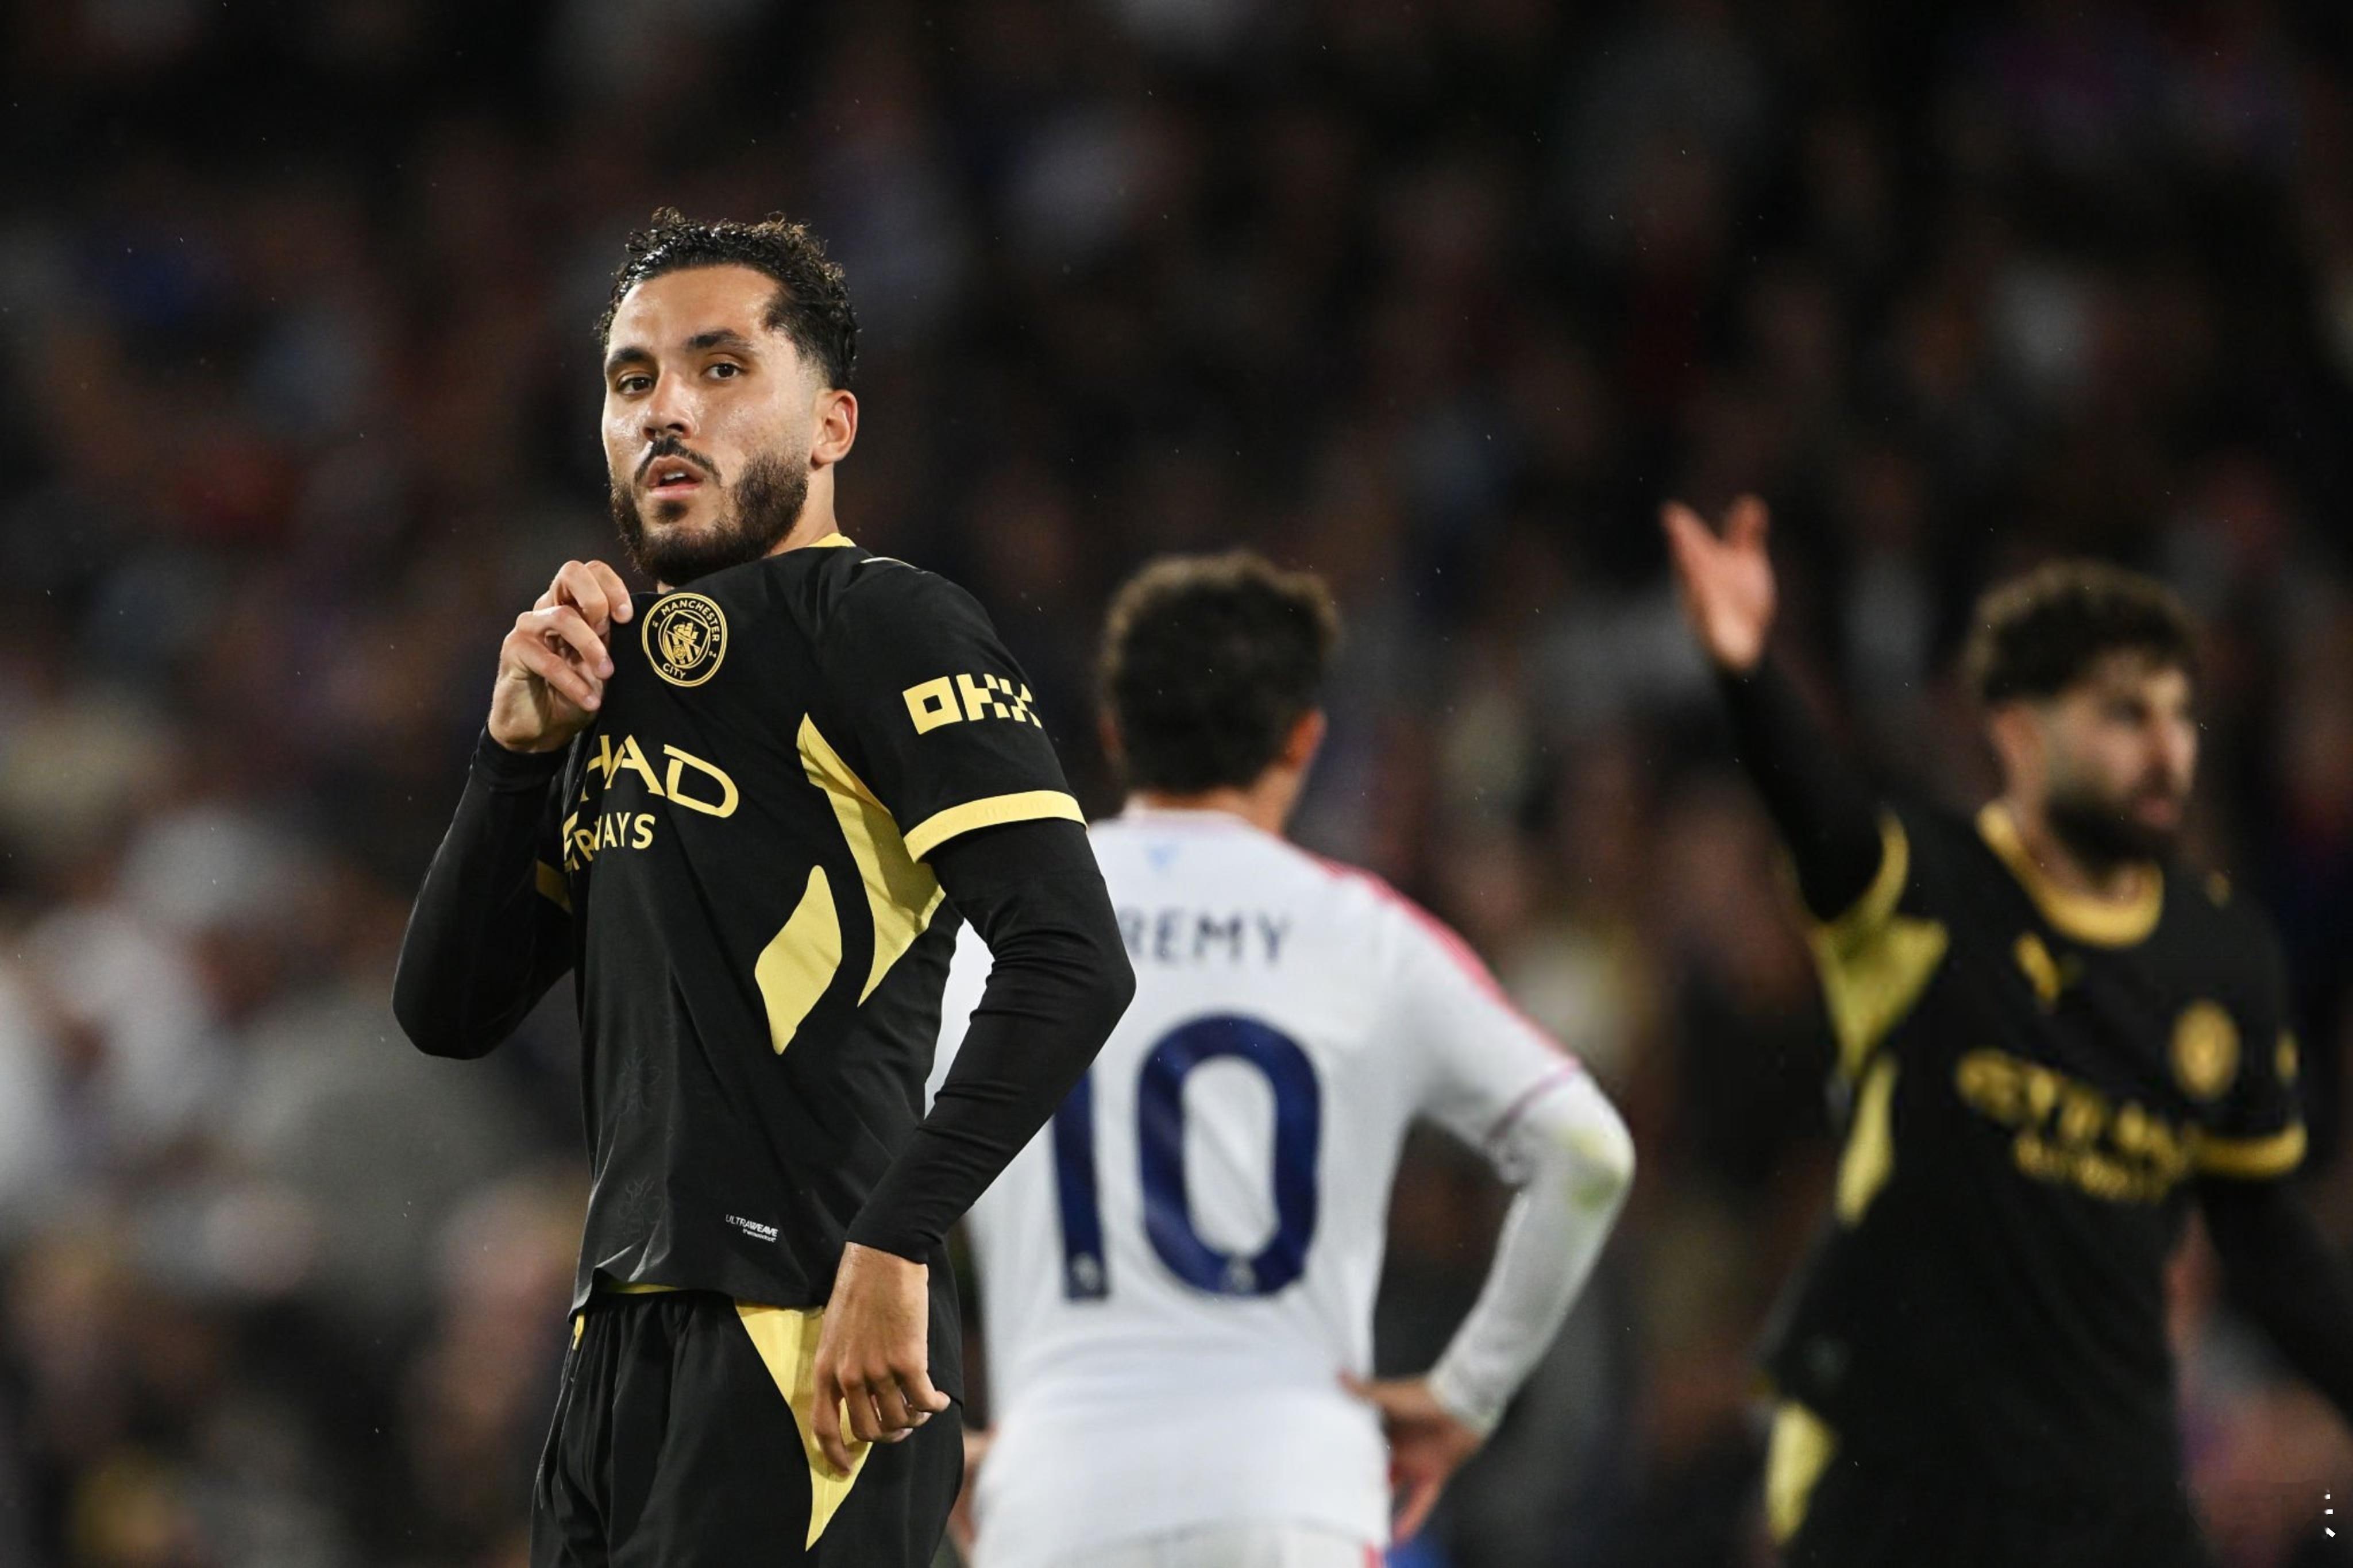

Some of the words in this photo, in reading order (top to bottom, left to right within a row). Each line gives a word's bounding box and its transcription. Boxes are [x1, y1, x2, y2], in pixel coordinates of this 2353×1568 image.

[661, 599, 719, 642] MANCHESTER
[662, 663, 686, 679] CITY
[1117, 906, 1293, 965] REMY
[1050, 1013, 1321, 1299] 10
[726, 1214, 778, 1237] ULTRAWEAVE
